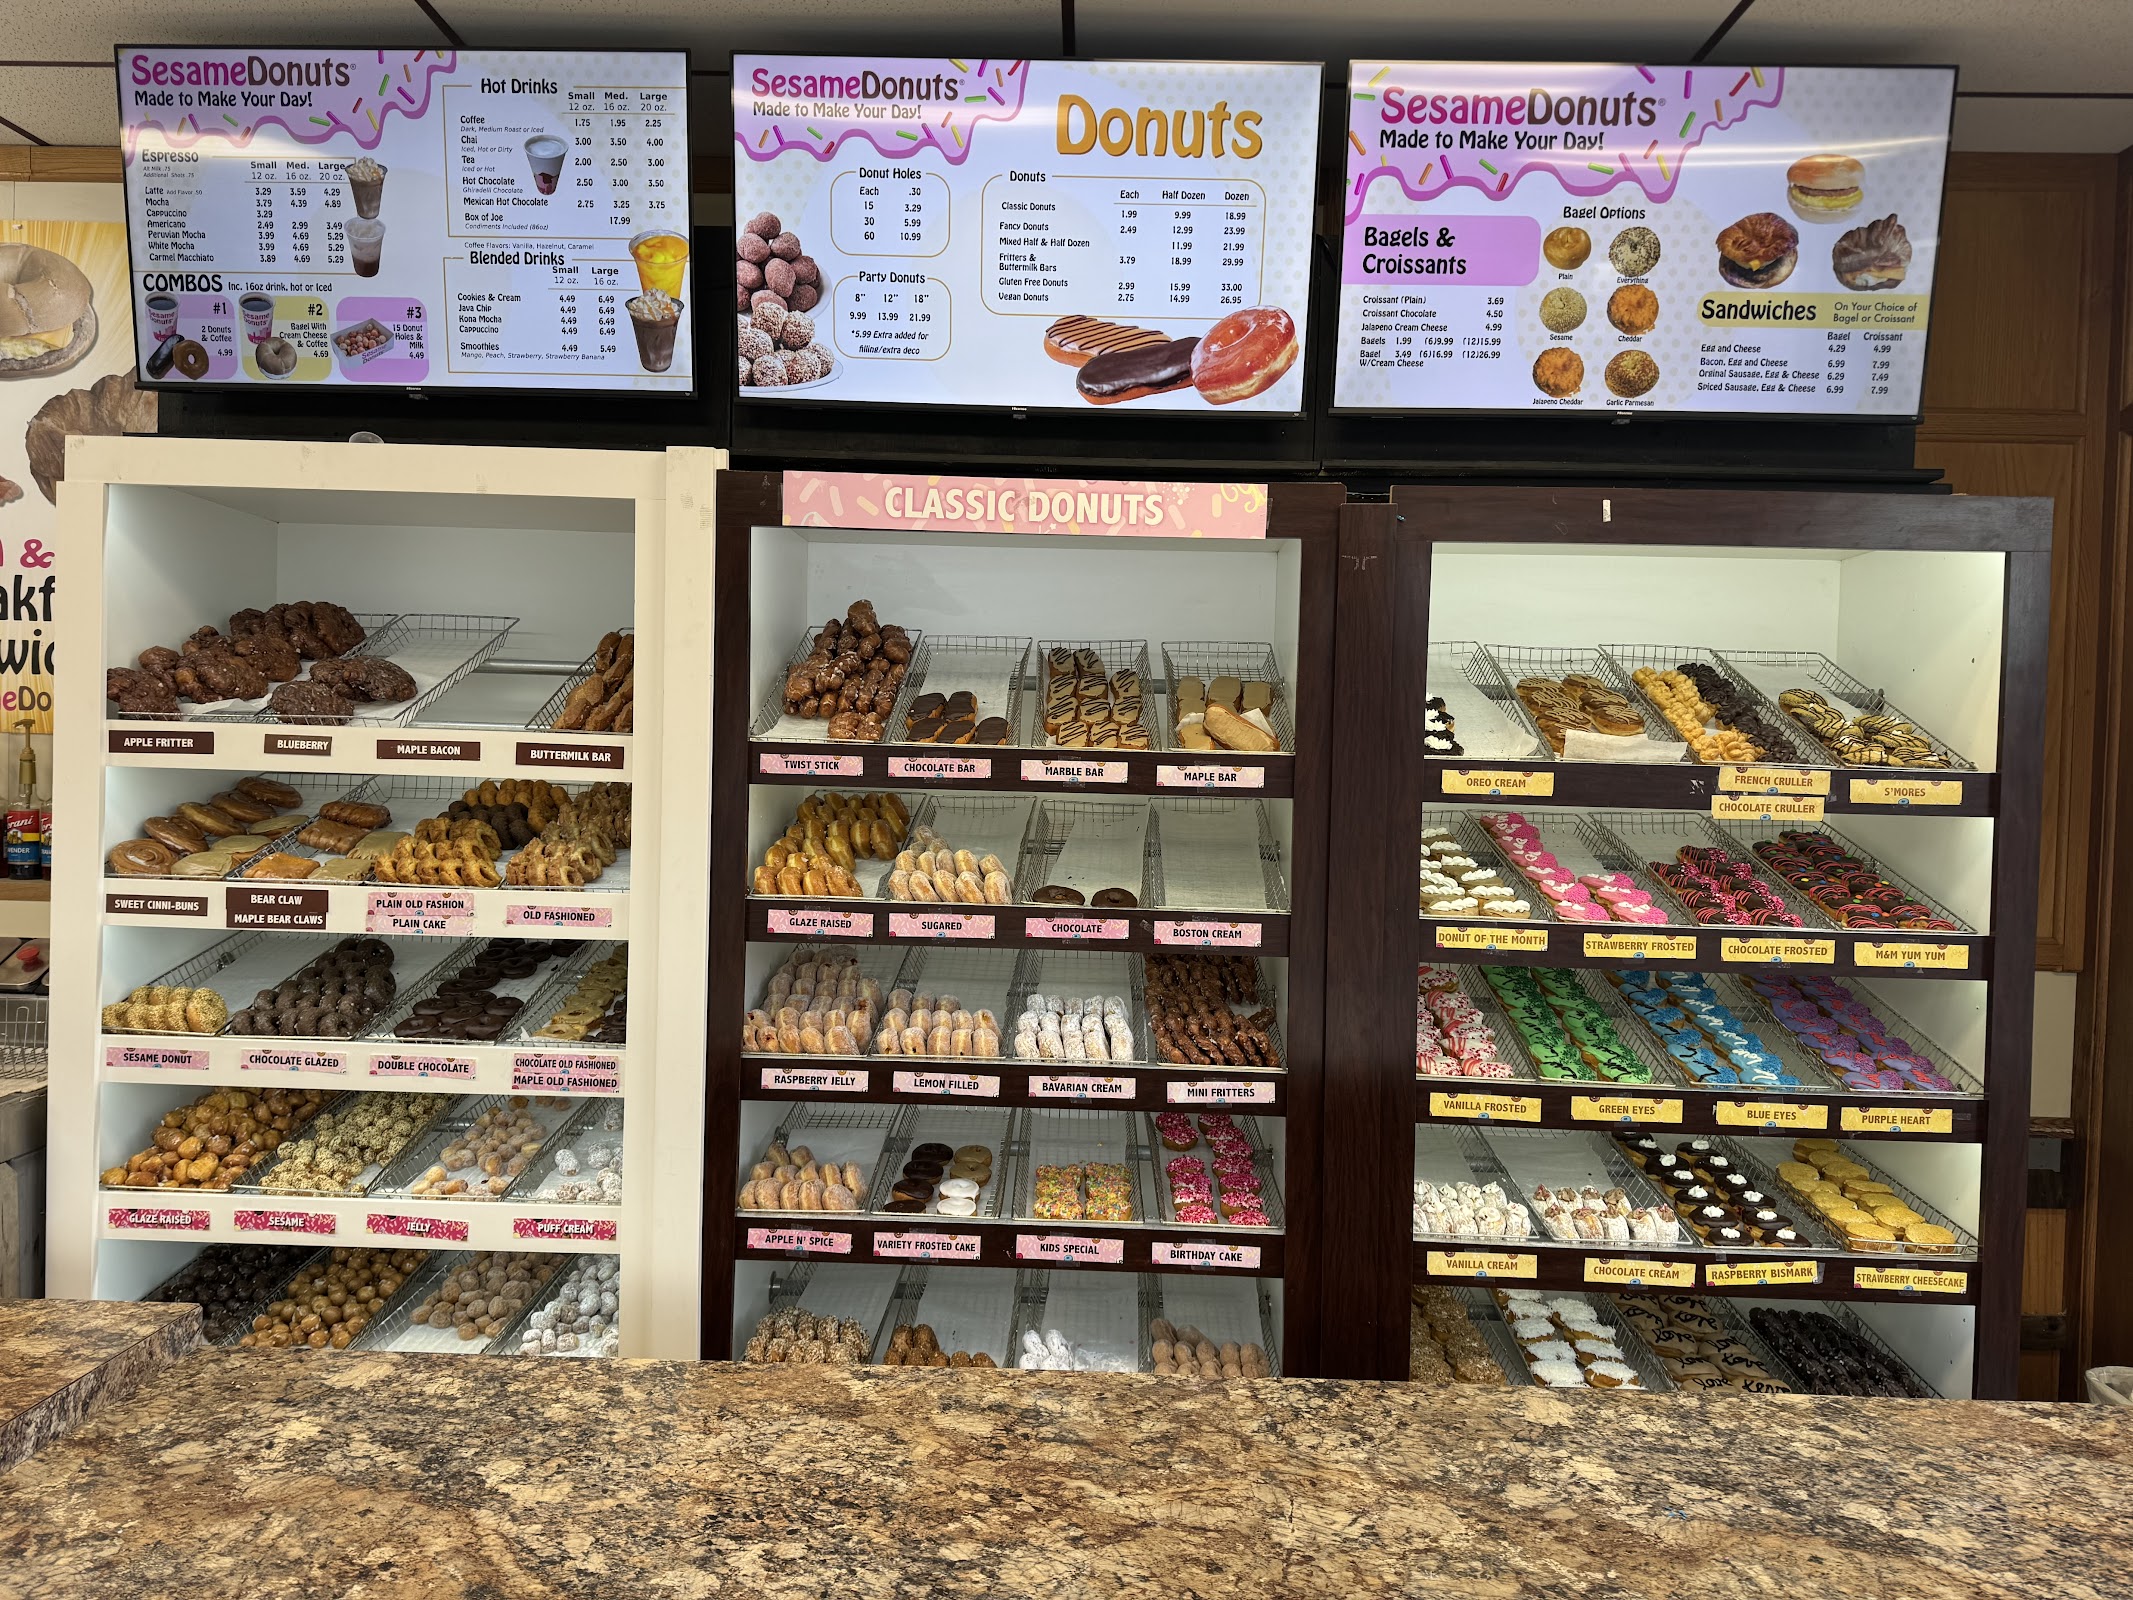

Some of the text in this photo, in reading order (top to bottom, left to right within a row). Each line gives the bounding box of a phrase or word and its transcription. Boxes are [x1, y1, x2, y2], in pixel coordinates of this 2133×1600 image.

[481, 78, 557, 95] Hot Drinks
[134, 91, 312, 108] Made to Make Your Day!
[753, 101, 922, 121] Made to Make Your Day!
[461, 115, 484, 124] Coffee
[1055, 93, 1263, 160] Donuts
[1380, 129, 1604, 154] Made to Make Your Day!
[142, 149, 198, 163] Espresso
[859, 167, 921, 179] Donut Holes
[1002, 202, 1055, 211] Classic Donuts
[1563, 206, 1645, 219] Bagel Options
[465, 213, 503, 222] Box of Joe
[1364, 226, 1455, 249] Bagels &
[470, 251, 564, 266] Blended Drinks
[1363, 253, 1467, 276] Croissants
[143, 274, 223, 292] COMBOS
[859, 272, 925, 284] Party Donuts
[1702, 299, 1816, 321] Sandwiches
[461, 342, 499, 351] Smoothies
[885, 487, 1163, 525] CLASSIC DONUTS
[20, 538, 55, 568] &
[124, 738, 193, 748] APPLE FRITTER
[277, 739, 328, 750] BLUEBERRY
[397, 744, 460, 756] MAPLE BACON
[530, 749, 611, 762] BUTTERMILK BAR
[784, 759, 839, 770] TWIST STICK
[904, 762, 975, 774] CHOCOLATE BAR
[1045, 766, 1104, 778] MARBLE BAR
[1184, 771, 1237, 783] MAPLE BAR
[1466, 777, 1526, 788] OREO CREAM
[1735, 774, 1813, 788] FRENCH CRULLER
[1884, 786, 1926, 797] S'MORES
[1719, 802, 1815, 814] CHOCOLATE CRULLER
[115, 899, 199, 911] SWEET CINNI-BUNS
[251, 894, 303, 906] BEAR CLAW
[376, 899, 464, 910] PLAIN OLD FASHION
[235, 914, 323, 925] MAPLE BEAR CLAWS
[523, 910, 595, 922] OLD FASHIONED
[393, 918, 446, 929] PLAIN CAKE
[789, 917, 851, 929] GLAZE RAISED
[922, 920, 962, 931] SUGARED
[1051, 923, 1102, 934] CHOCOLATE
[1173, 928, 1242, 939] BOSTON CREAM
[1438, 932, 1545, 946] DONUT OF THE MONTH
[1586, 940, 1694, 952] STRAWBERRY FROSTED
[1728, 944, 1828, 956] CHOCOLATE FROSTED
[1875, 949, 1945, 961] M&M YUM YUM
[124, 1053, 192, 1064] SESAME DONUT
[249, 1054, 339, 1067] CHOCOLATE GLAZED
[516, 1057, 616, 1070] CHOCOLATE OLD FASHIONED
[378, 1061, 469, 1073] DOUBLE CHOCOLATE
[514, 1076, 617, 1088] MAPLE OLD FASHIONED
[774, 1074, 855, 1087] RASPBERRY JELLY
[914, 1079, 979, 1090] LEMON FILLED
[1042, 1082, 1122, 1093] BAVARIAN CREAM
[1187, 1087, 1255, 1098] MINI FRITTERS
[1443, 1101, 1527, 1114] VANILLA FROSTED
[1599, 1103, 1655, 1116] GREEN EYES
[1747, 1109, 1796, 1121] BLUE EYES
[1862, 1114, 1930, 1126] PURPLE HEART
[130, 1214, 191, 1224] GLAZE RAISED
[269, 1216, 304, 1227] SESAME
[407, 1222, 431, 1232] JELLY
[538, 1223, 593, 1234] PUFF CREAM
[765, 1234, 834, 1247] APPLE N' SPICE
[877, 1239, 976, 1252] VARIETY FROSTED CAKE
[1040, 1243, 1099, 1255] KIDS SPECIAL
[1170, 1249, 1242, 1261] BIRTHDAY CAKE
[1446, 1259, 1518, 1271] VANILLA CREAM
[1594, 1265, 1680, 1280] CHOCOLATE CREAM
[1711, 1267, 1813, 1280] RASPBERRY BISMARK
[1856, 1272, 1964, 1288] STRAWBERRY CHEESECAKE
